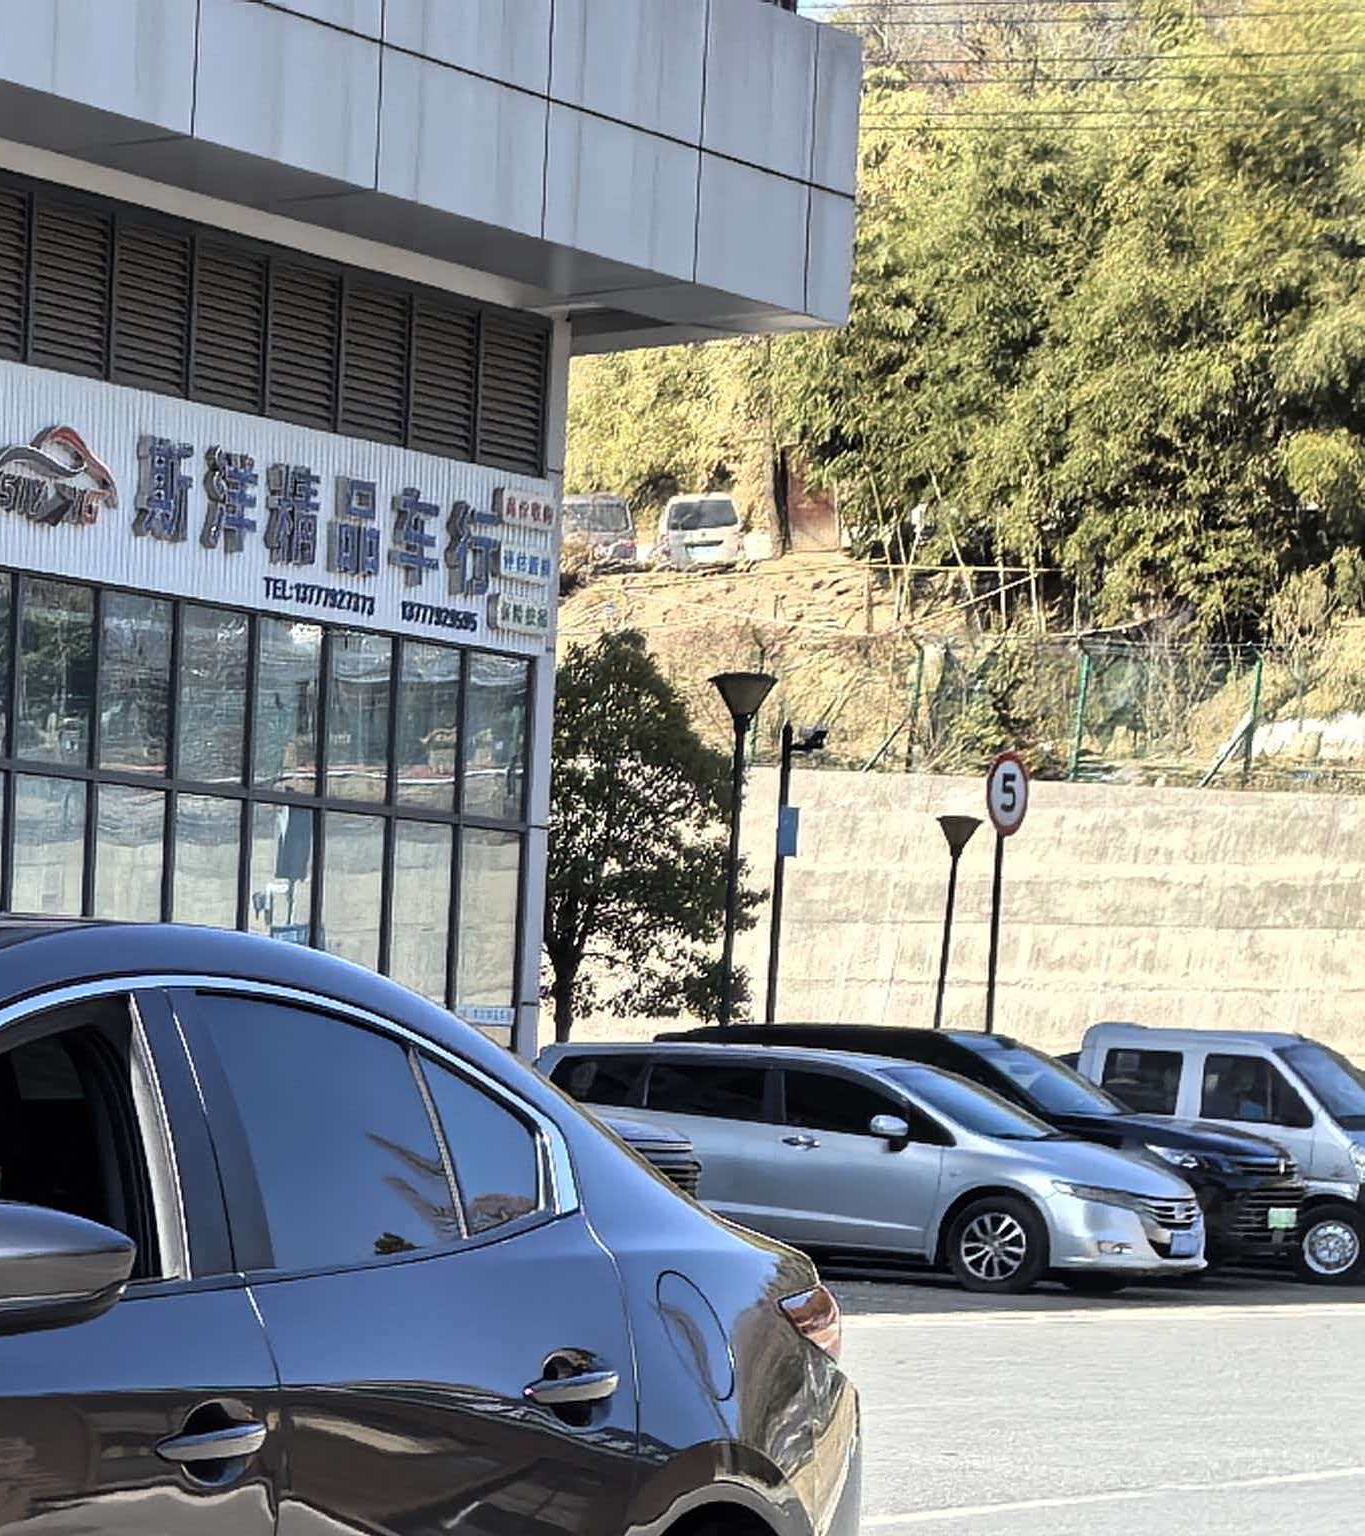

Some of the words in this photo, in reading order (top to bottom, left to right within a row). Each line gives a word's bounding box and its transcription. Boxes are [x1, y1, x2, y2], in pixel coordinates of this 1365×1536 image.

[134, 434, 499, 597] 斯洋精品车行
[1000, 772, 1017, 813] 5
